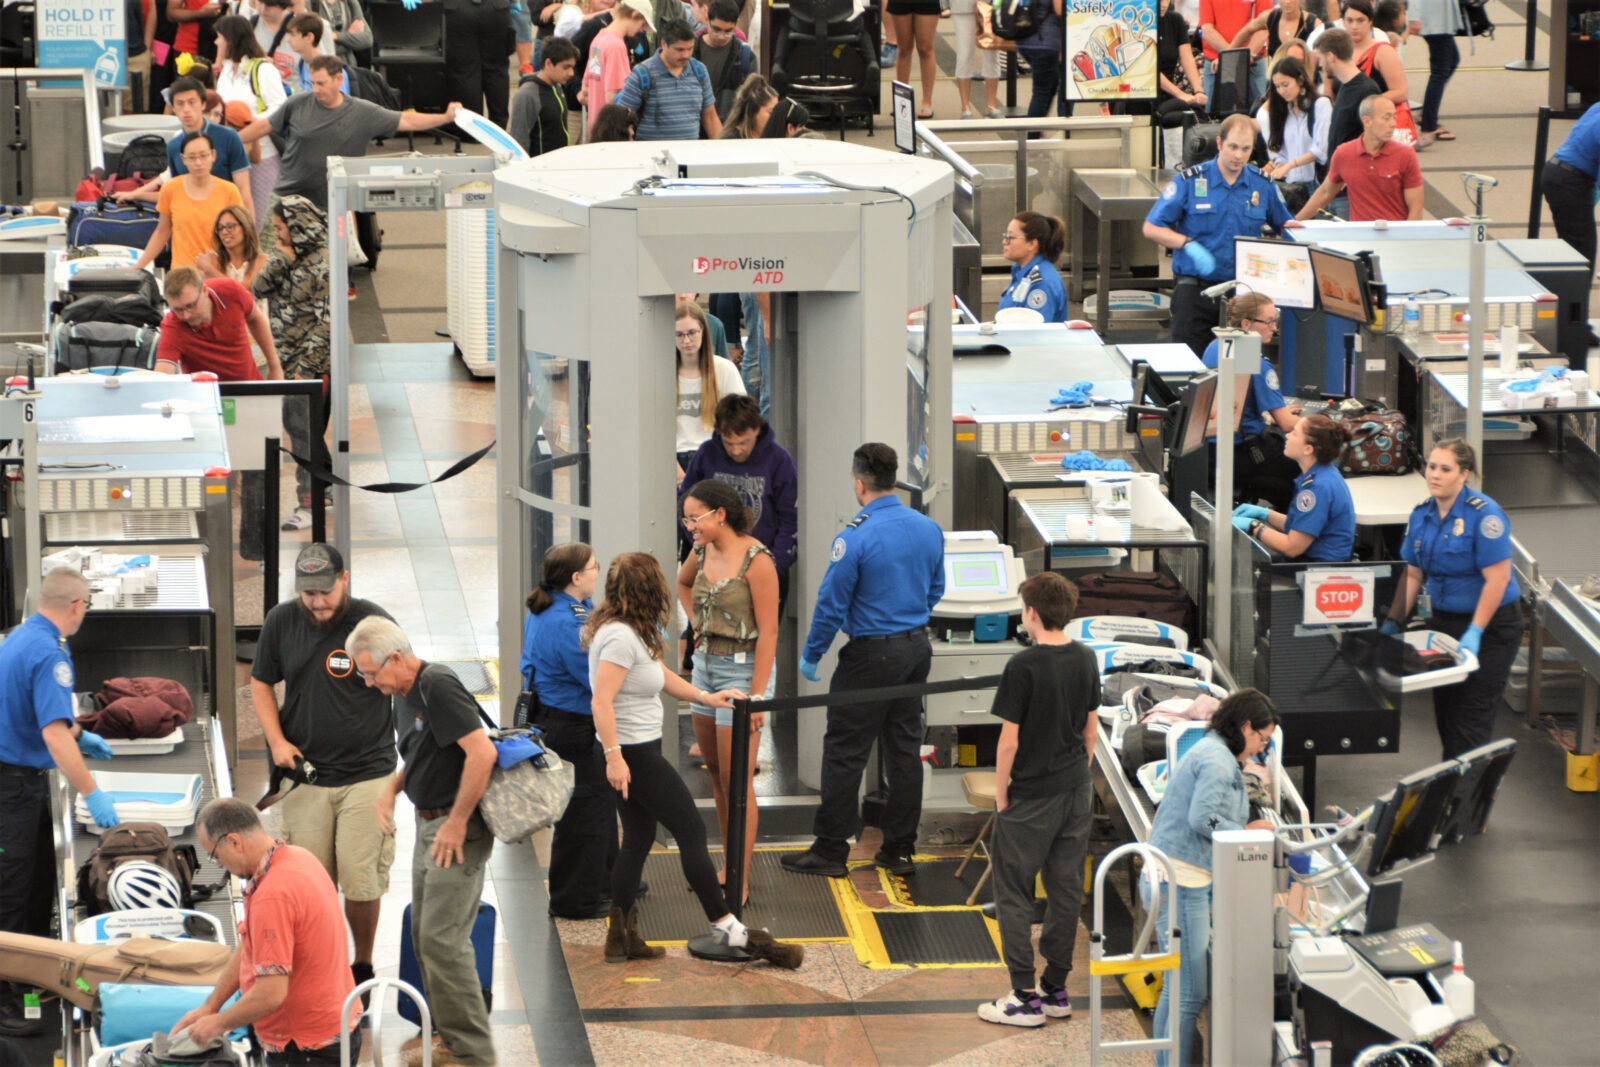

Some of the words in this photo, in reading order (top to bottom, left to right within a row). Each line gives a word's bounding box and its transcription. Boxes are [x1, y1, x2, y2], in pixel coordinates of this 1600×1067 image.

[45, 8, 94, 22] HOLD
[99, 8, 115, 21] IT
[1073, 1, 1113, 16] Safely!
[45, 24, 97, 36] REFILL
[102, 24, 115, 36] IT
[1478, 225, 1484, 243] 8
[712, 257, 785, 271] ProVision
[752, 271, 784, 284] ATD
[1225, 339, 1233, 358] 7
[25, 403, 33, 422] 6
[1321, 590, 1359, 604] STOP
[1237, 852, 1268, 861] iLane
